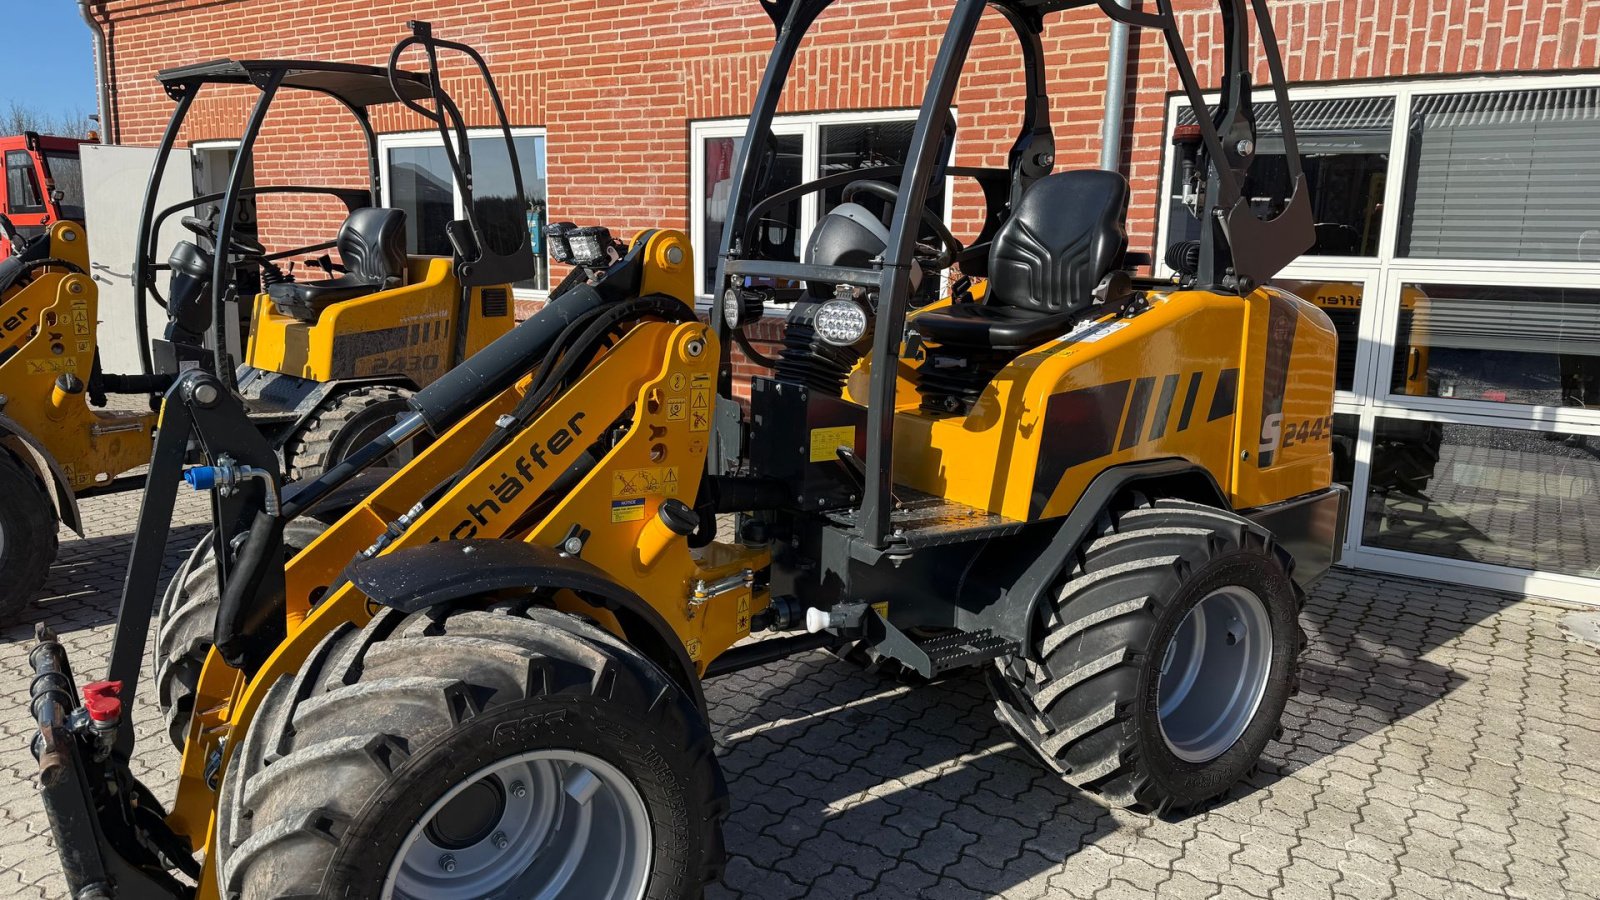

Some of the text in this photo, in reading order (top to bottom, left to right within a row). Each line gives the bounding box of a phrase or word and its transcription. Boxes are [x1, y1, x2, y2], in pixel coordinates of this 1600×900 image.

[0, 306, 29, 339] er
[372, 354, 440, 374] 2430
[1258, 412, 1333, 452] S 2445
[429, 412, 586, 543] chäffer
